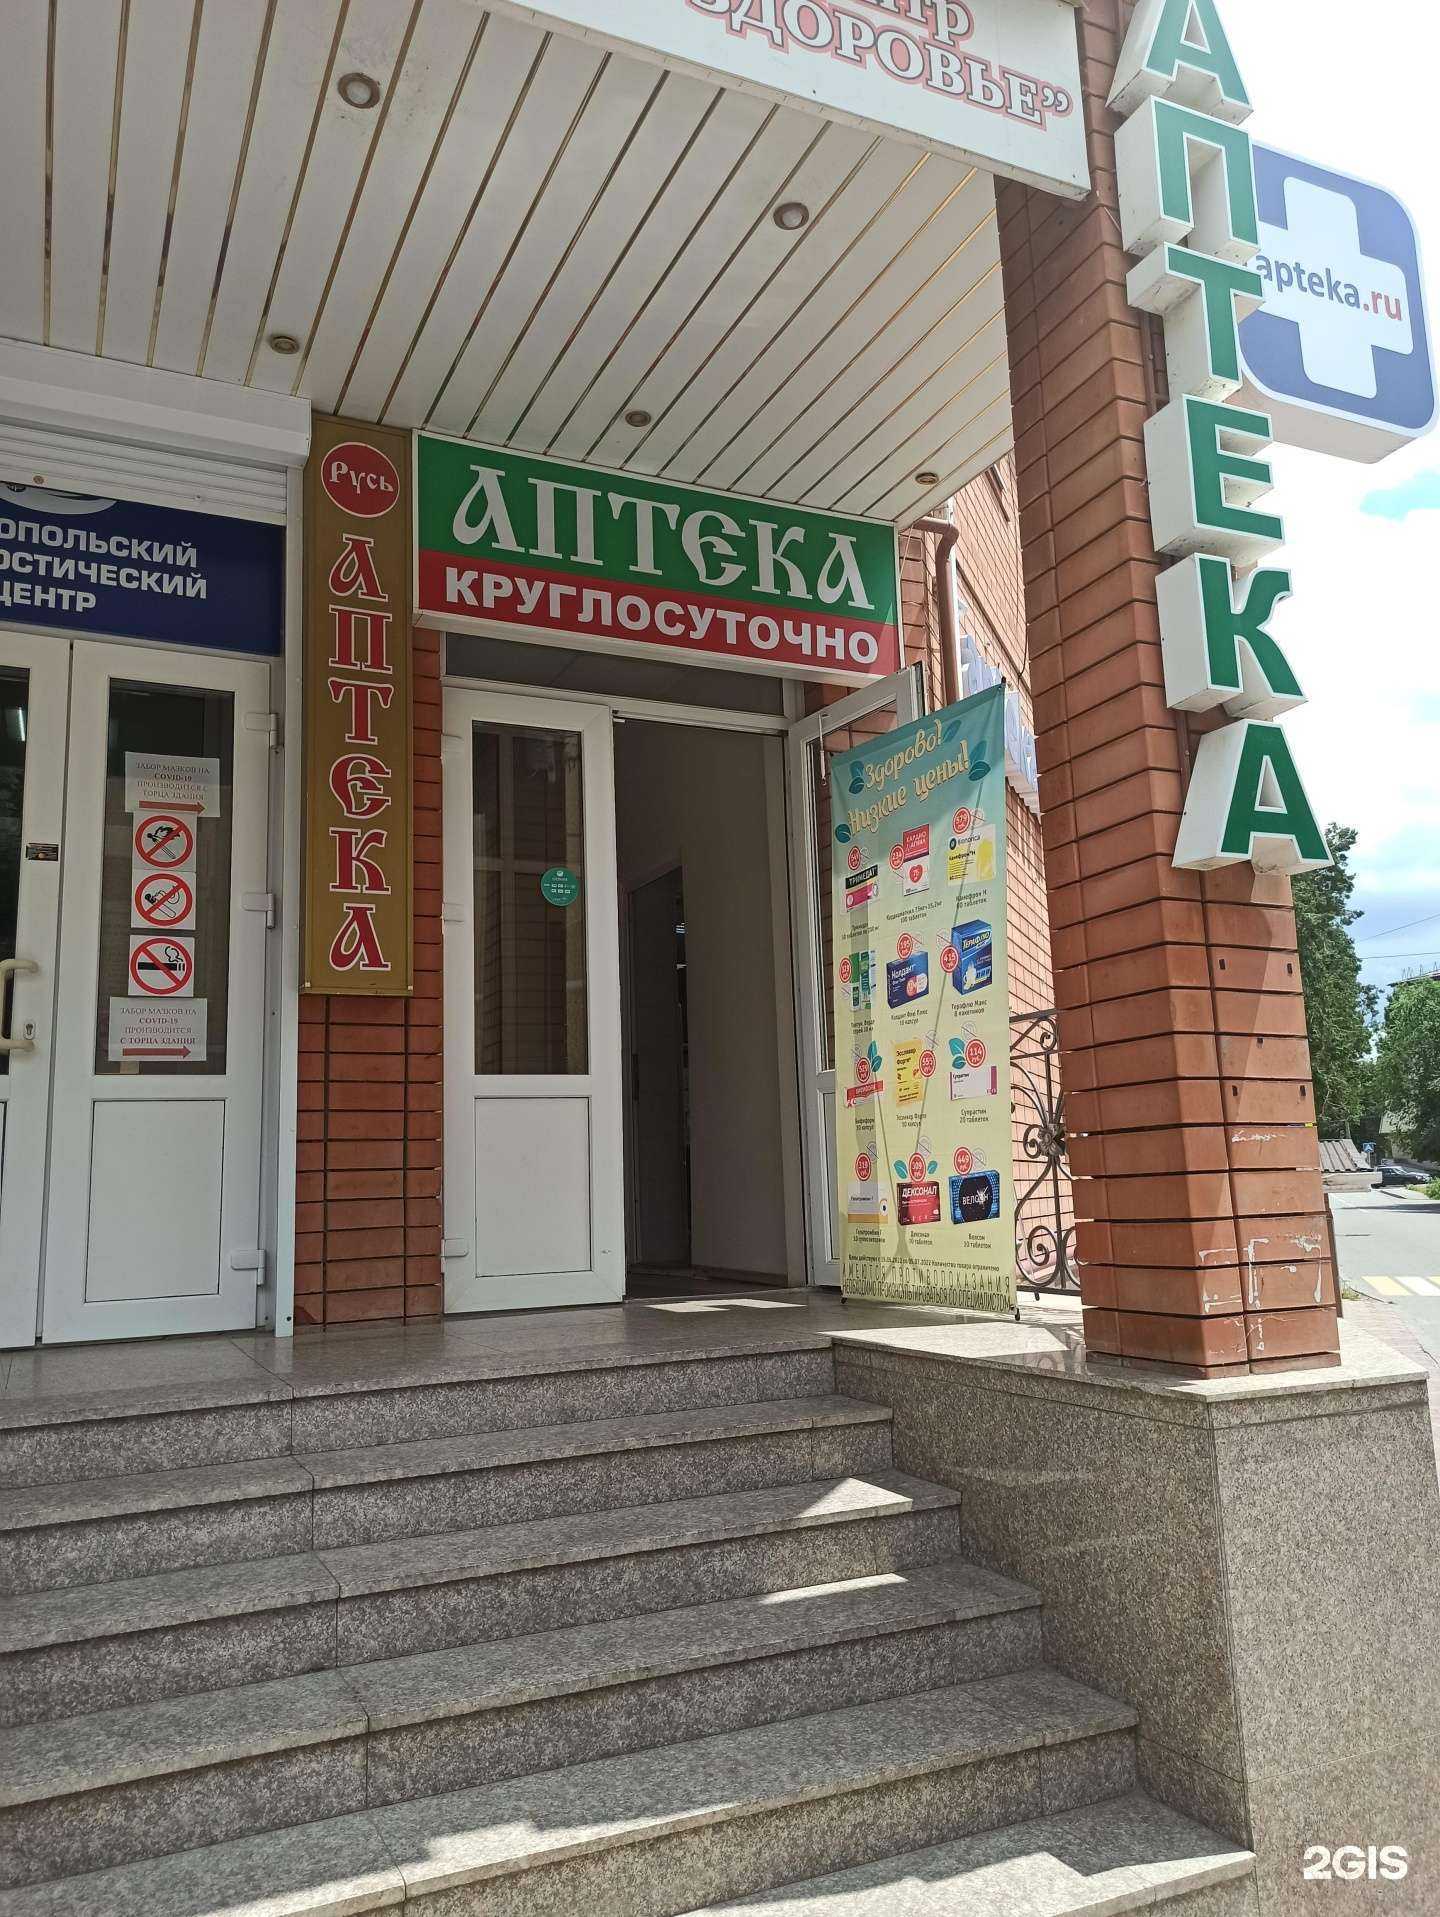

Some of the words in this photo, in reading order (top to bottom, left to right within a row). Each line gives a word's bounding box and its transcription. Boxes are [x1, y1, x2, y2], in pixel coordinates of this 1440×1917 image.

[1255, 254, 1402, 321] apteka.ru
[1140, 0, 1332, 866] АПТЕКА
[329, 460, 394, 494] Русь
[0, 517, 197, 568] ОПОЛЬСКИЙ
[451, 464, 877, 610] АПТЕКА
[445, 565, 880, 666] КРУГЛОСУТОЧНО
[154, 773, 192, 782] COVID-19
[328, 532, 394, 972] АПТЕКА
[848, 785, 906, 836] Низкие
[912, 738, 970, 803] цены!
[865, 718, 942, 791] Здорово!
[891, 1266, 1010, 1294] ПРОТИВОПОКАЗАНИЯ
